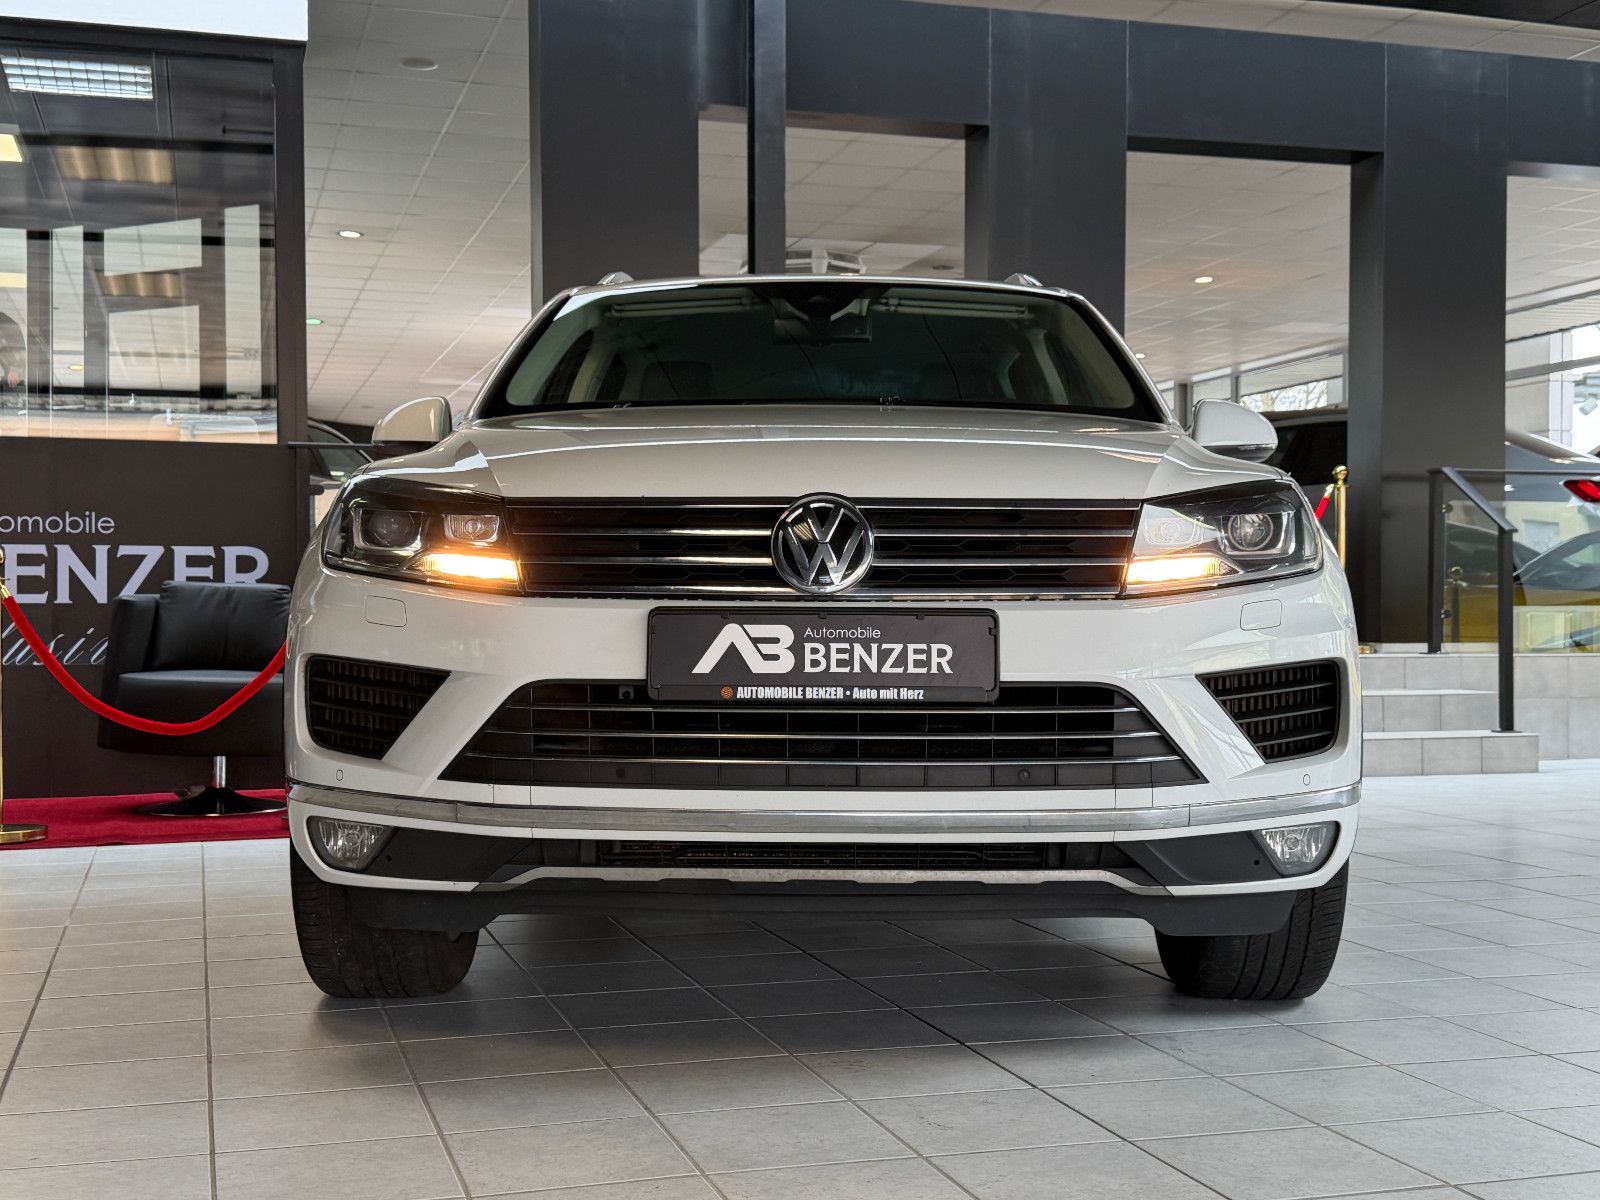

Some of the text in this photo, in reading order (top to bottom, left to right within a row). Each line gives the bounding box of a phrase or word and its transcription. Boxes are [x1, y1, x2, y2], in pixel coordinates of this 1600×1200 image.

[804, 627, 881, 639] Automobile
[803, 643, 953, 674] BENZER
[737, 687, 924, 700] AUTOMOBILE BENZER Auto mit Herz
